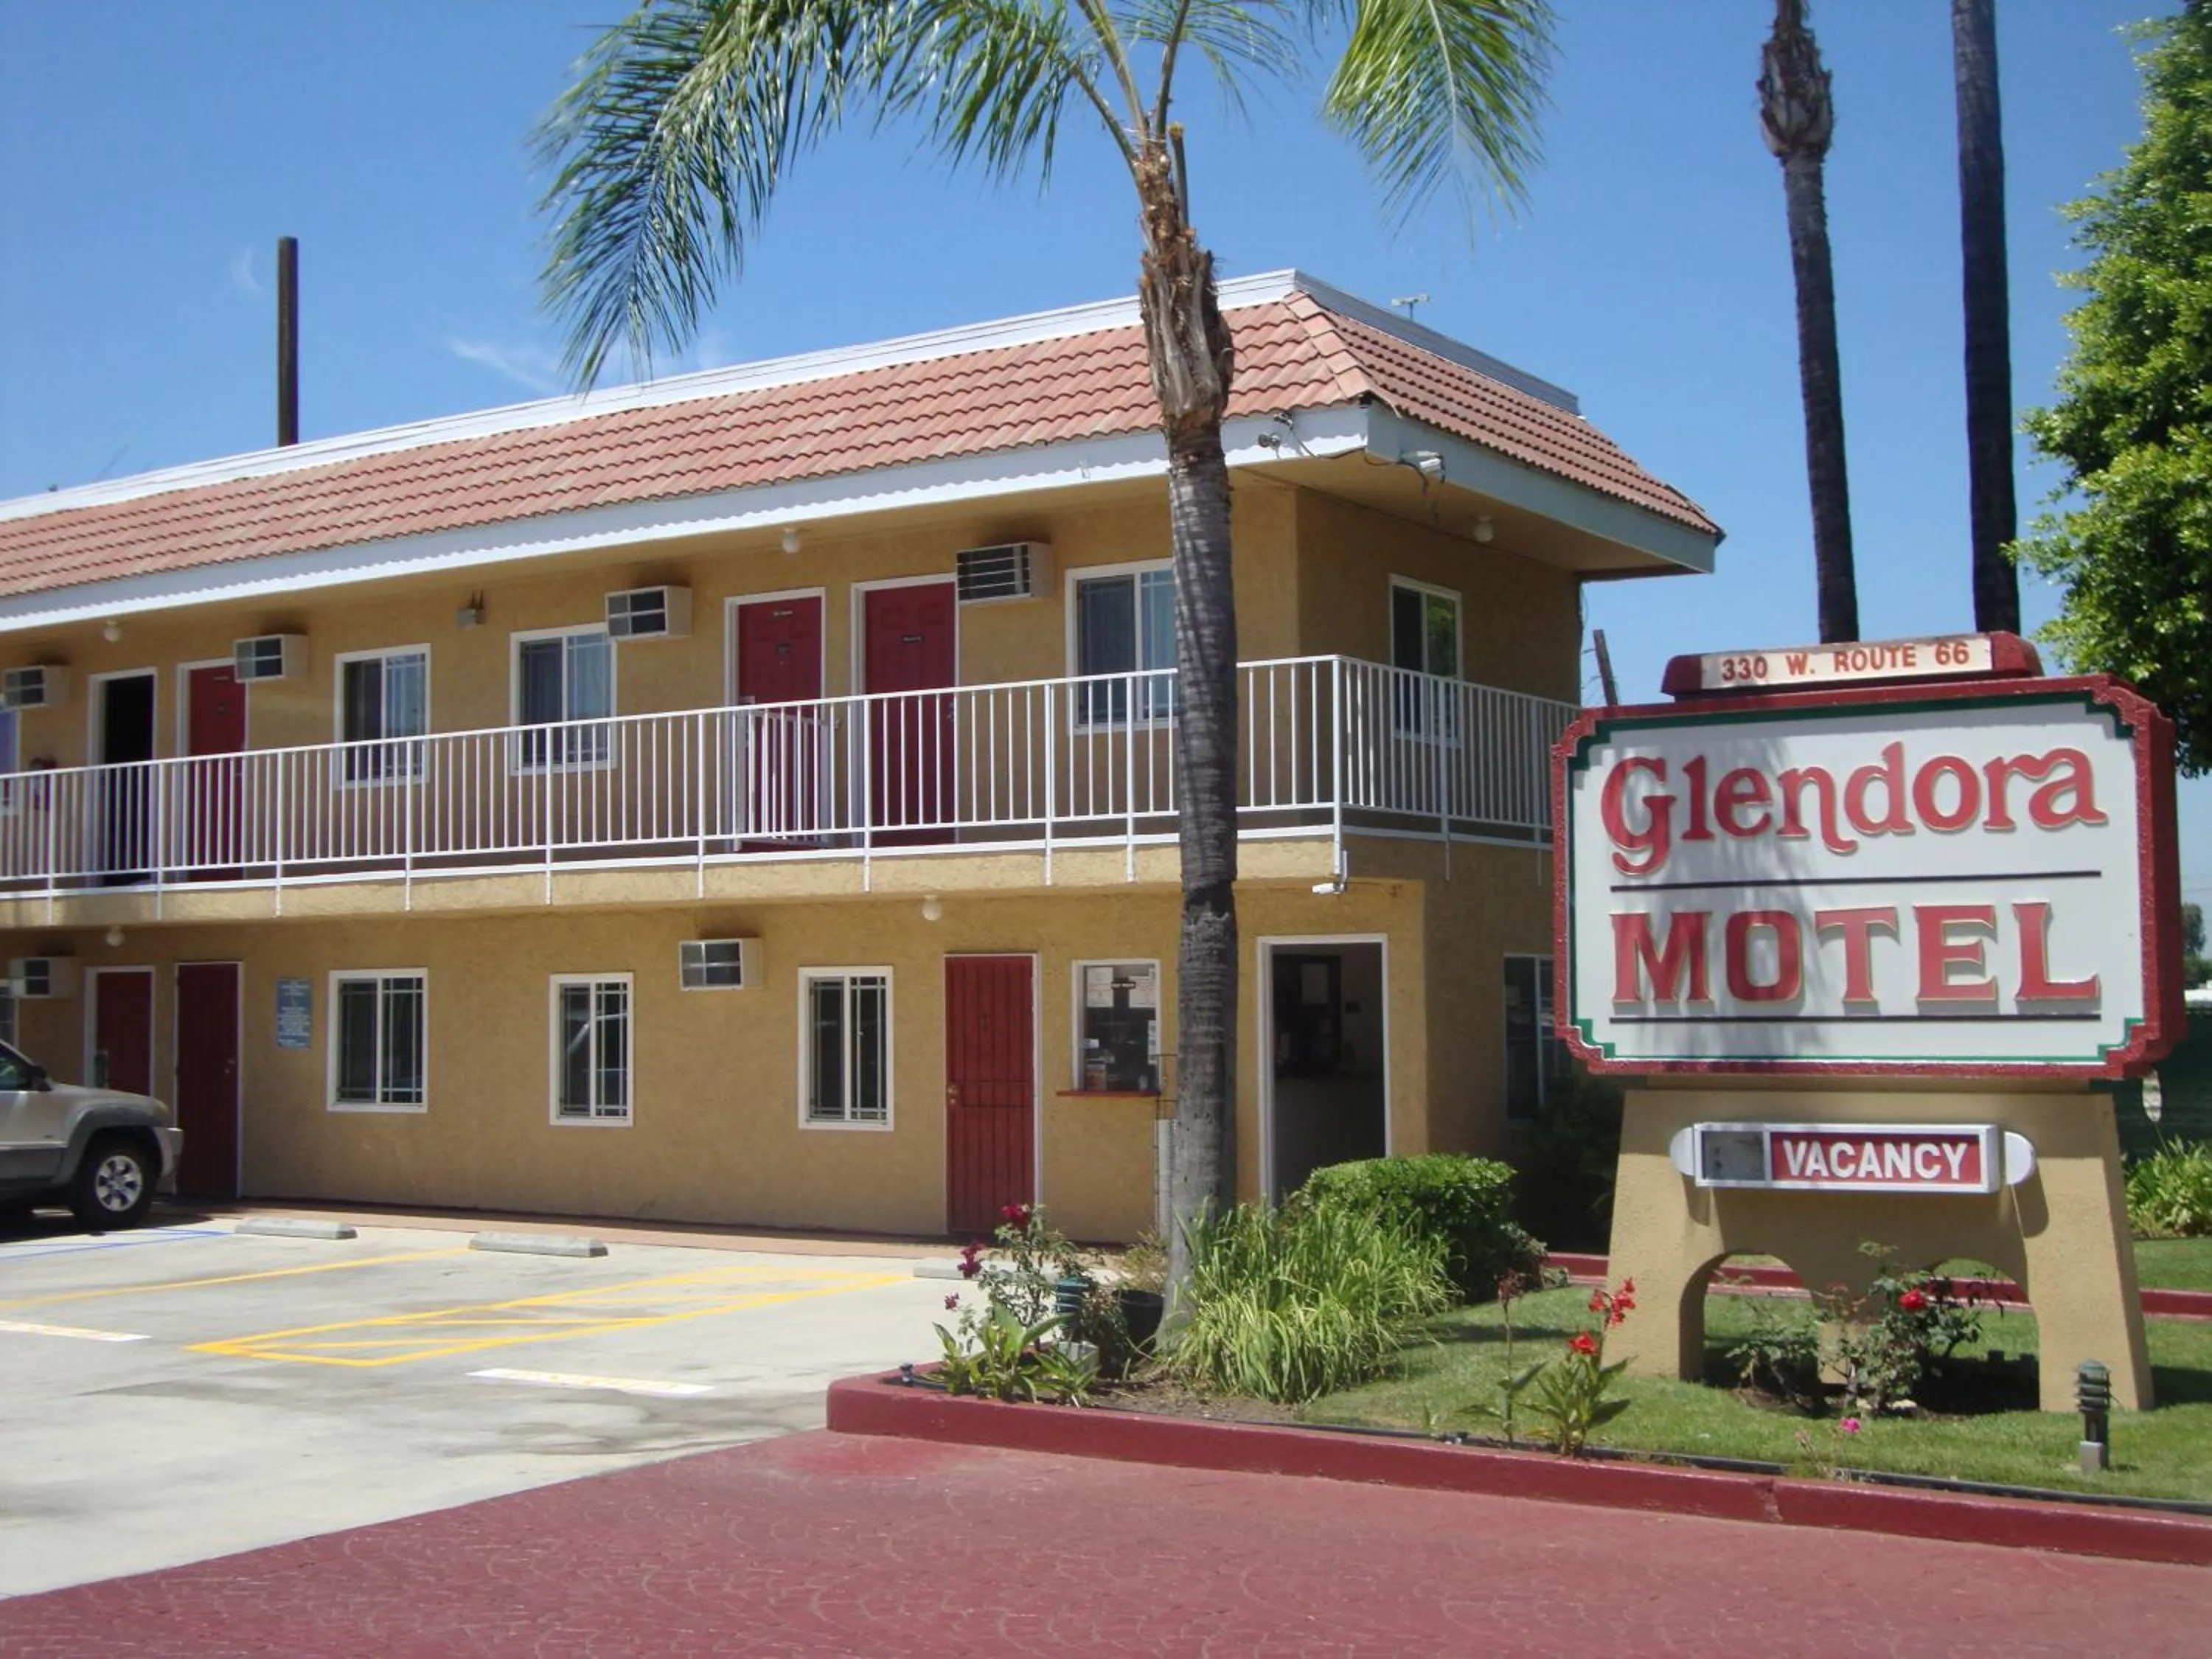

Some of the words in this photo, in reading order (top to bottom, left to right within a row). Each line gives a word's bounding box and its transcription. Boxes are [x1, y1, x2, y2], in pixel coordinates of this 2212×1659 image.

[1722, 655, 1767, 681] 330
[1787, 651, 1815, 676] W.
[1834, 645, 1916, 673] ROUTE
[1935, 641, 1970, 665] 66
[1601, 741, 2109, 875] Glendora
[1610, 902, 2100, 1003] MOTEL
[1782, 1140, 1967, 1180] VACANCY
